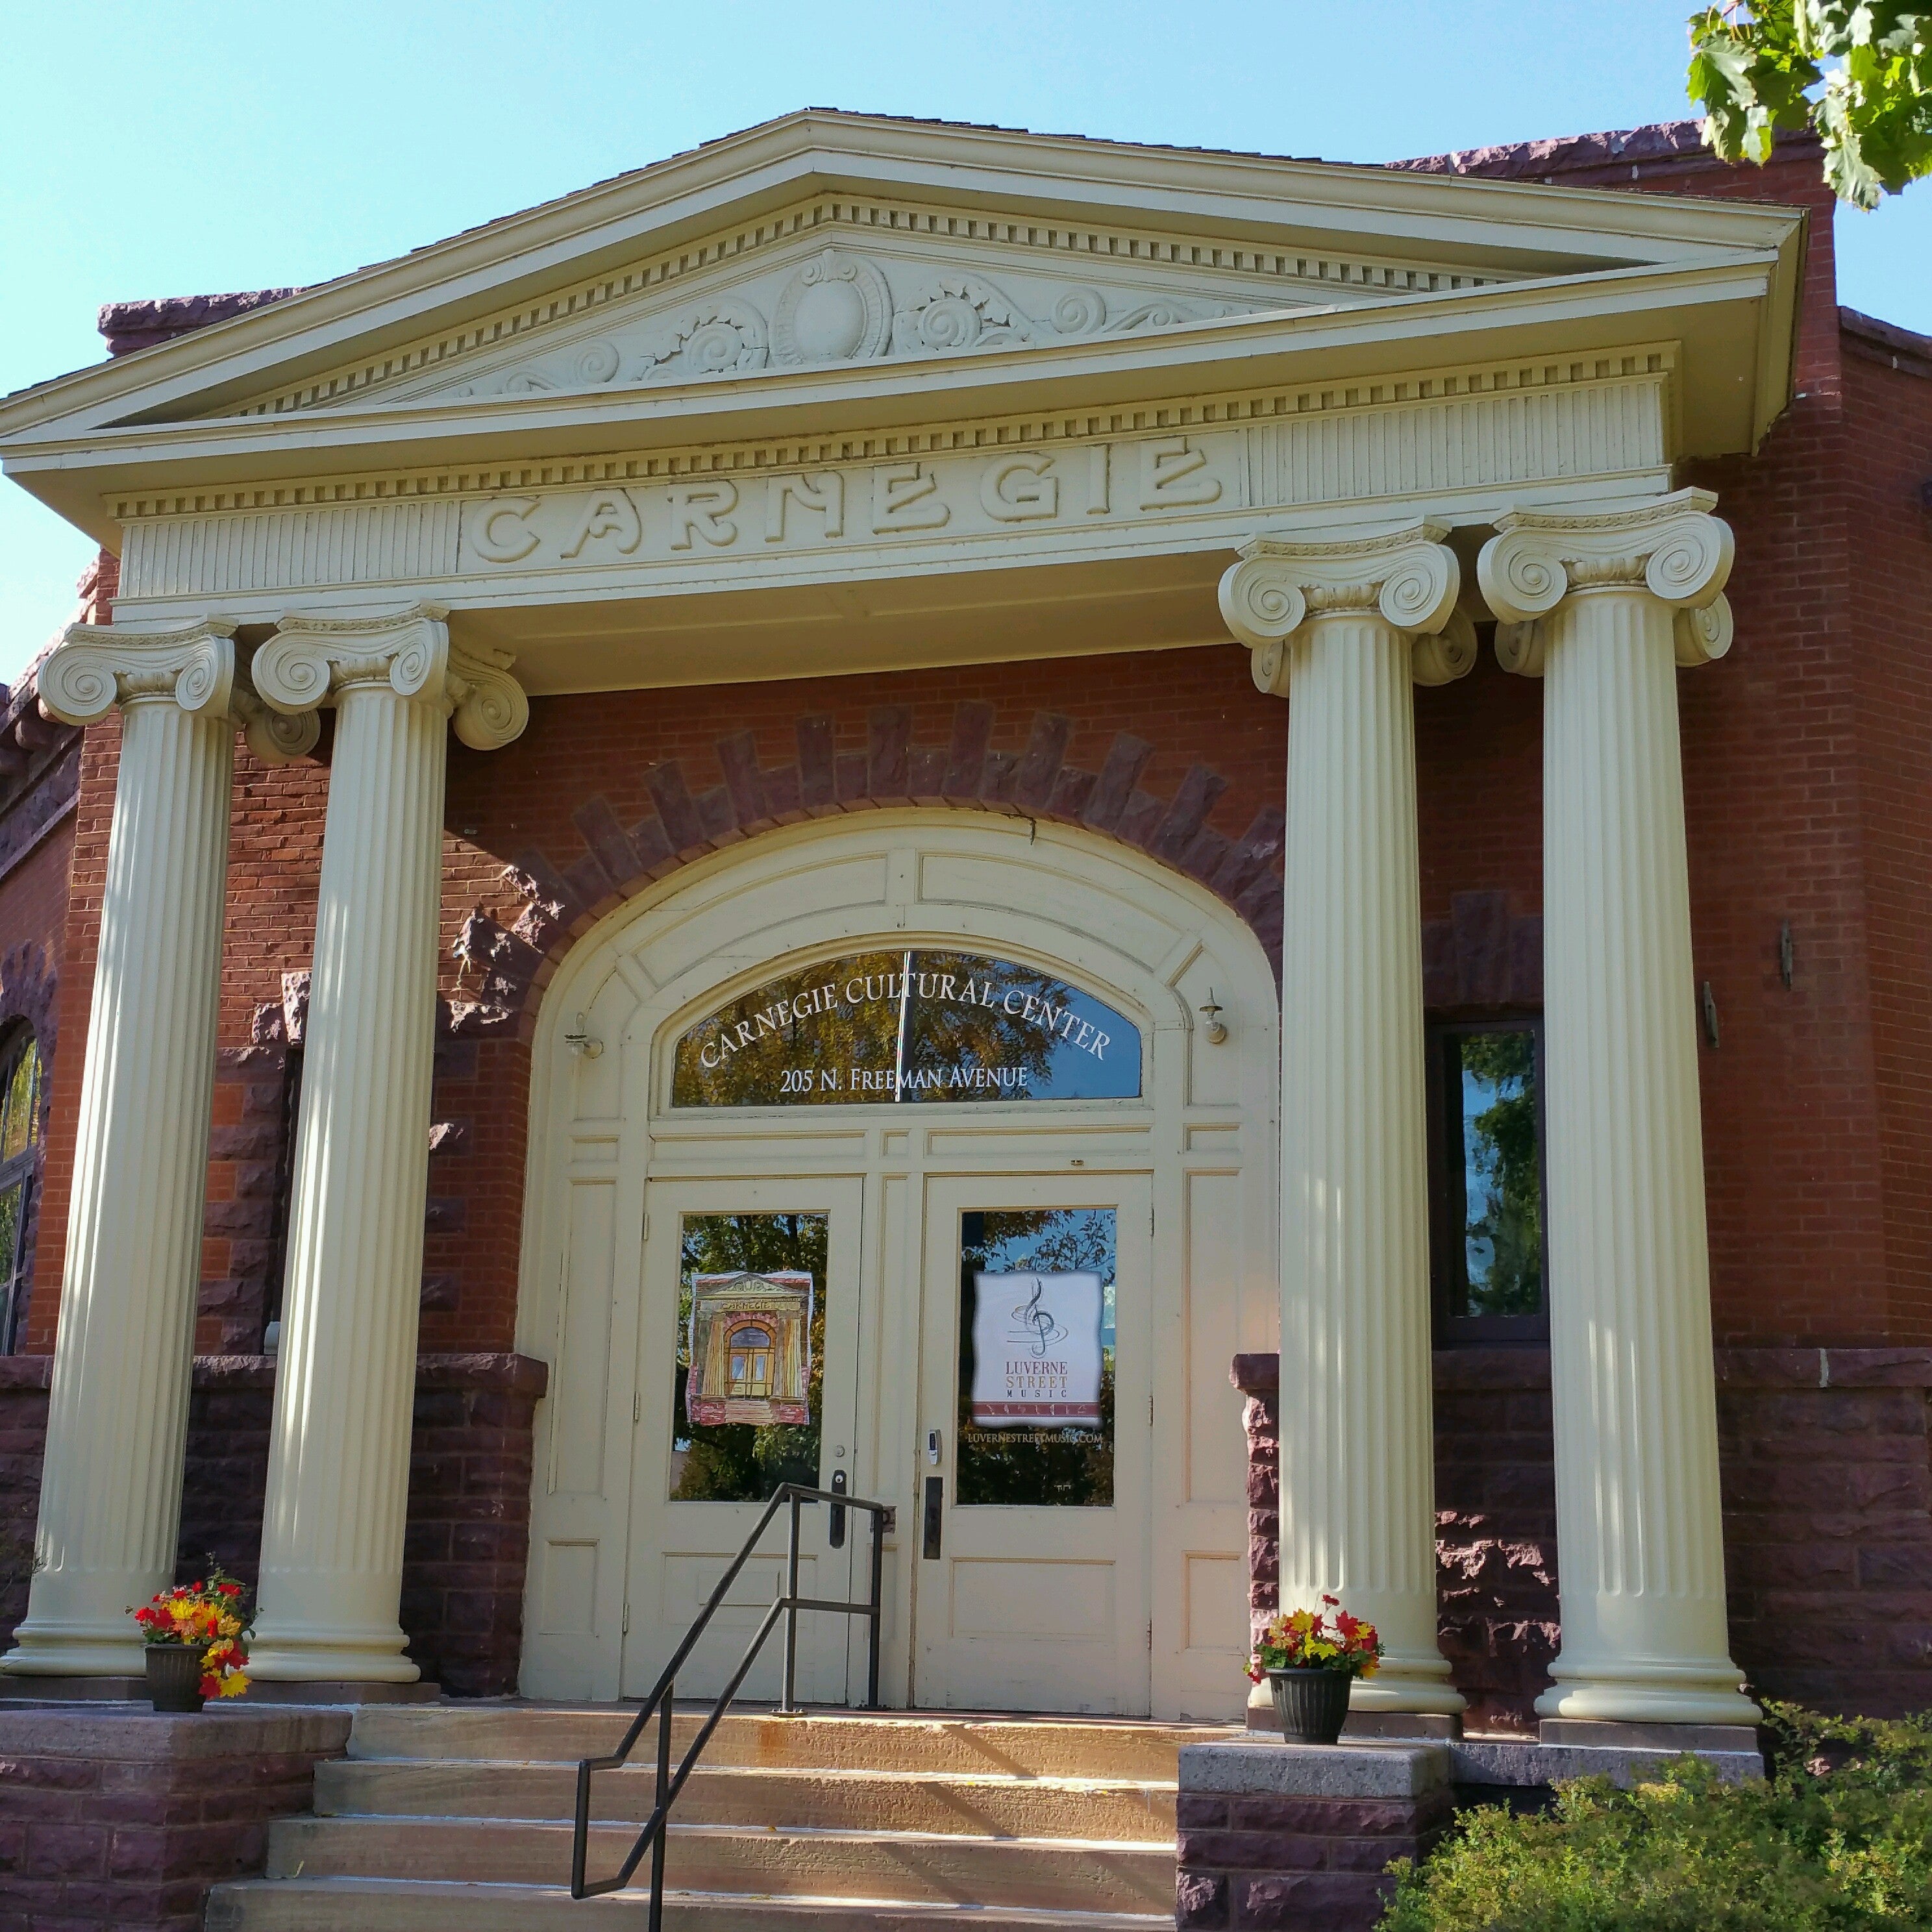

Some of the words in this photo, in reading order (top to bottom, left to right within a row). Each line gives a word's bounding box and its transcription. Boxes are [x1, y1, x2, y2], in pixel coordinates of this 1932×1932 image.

[470, 436, 1222, 564] CARNEGIE
[701, 984, 838, 1068] CARNEGIE
[846, 973, 994, 1008] CULTURAL
[1004, 990, 1111, 1061] CENTER
[780, 1070, 813, 1093] 205
[821, 1069, 842, 1091] N.
[1006, 1361, 1068, 1375] LUVERNE
[1006, 1376, 1067, 1389] STREET
[1007, 1389, 1067, 1398] MUSIC
[968, 1432, 1102, 1443] LUVERNESTREETMUSIC.COM
